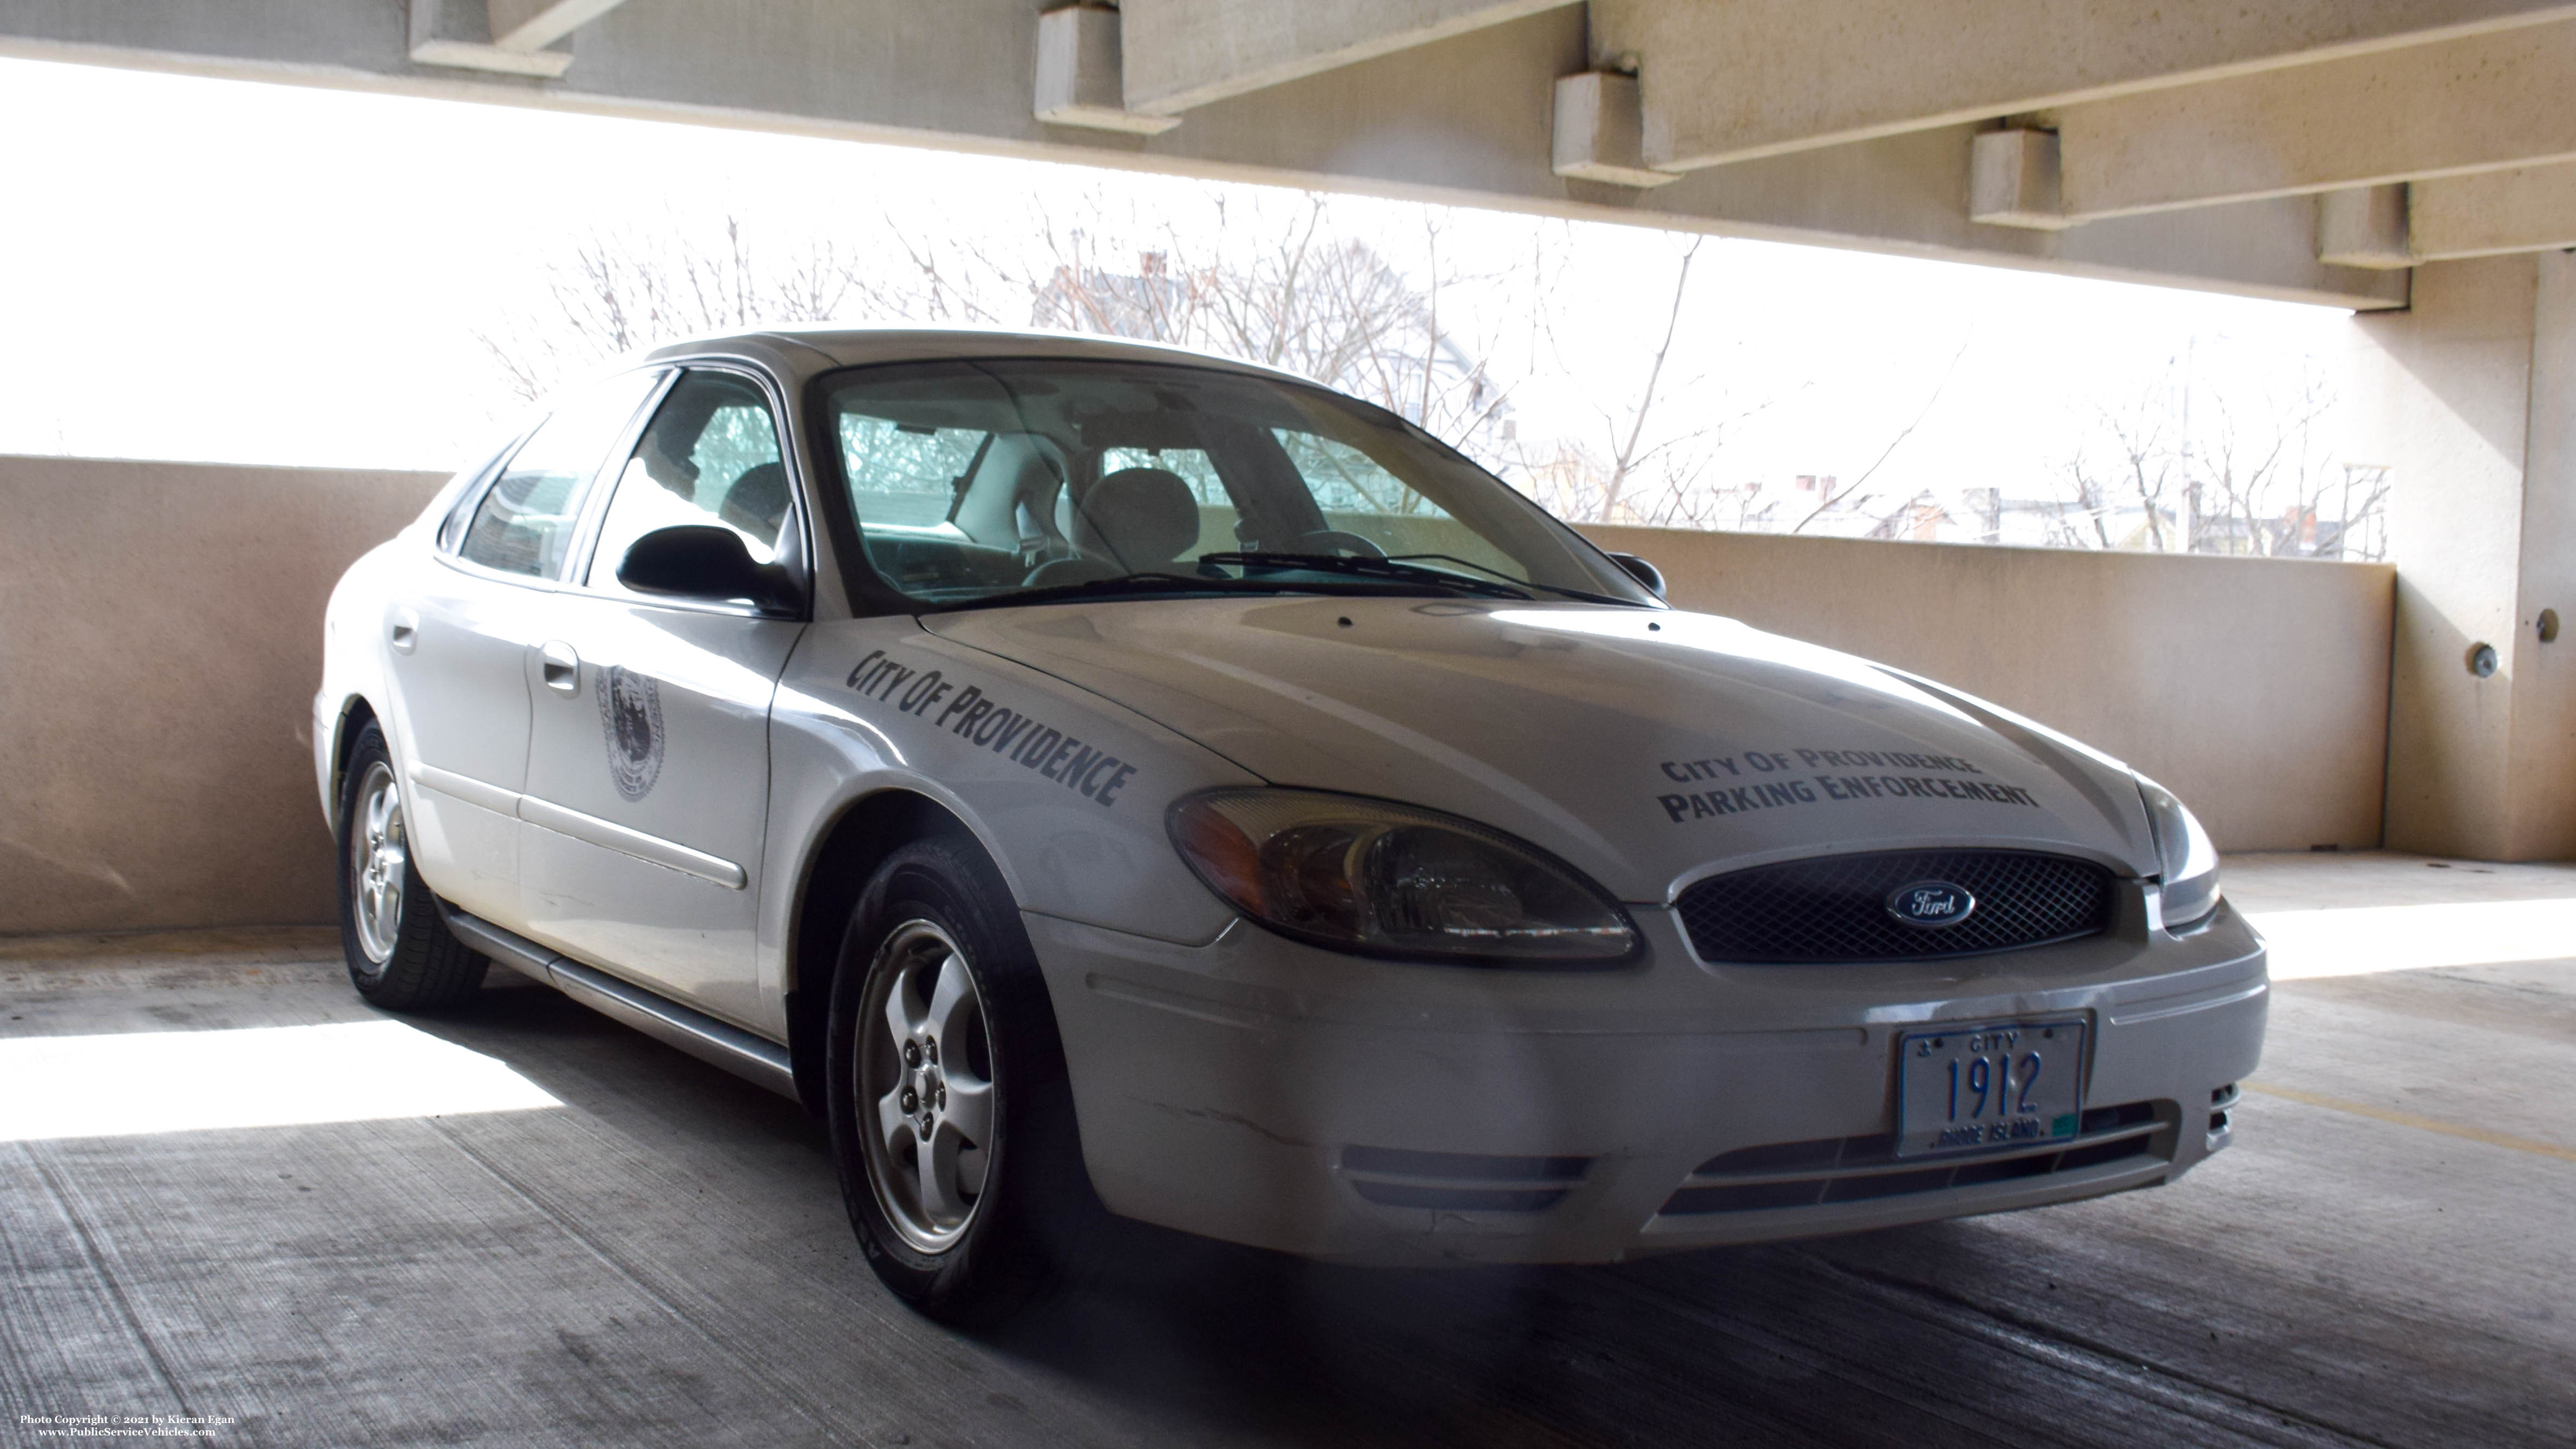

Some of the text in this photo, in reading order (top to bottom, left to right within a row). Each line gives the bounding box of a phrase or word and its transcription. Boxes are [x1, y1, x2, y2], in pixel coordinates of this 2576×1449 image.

[846, 650, 1137, 807] CITY OF PROVIDENCE
[1660, 748, 1983, 782] CITY OF PROVIDENCE
[1657, 775, 2041, 823] PARKING ENFORCEMENT
[1911, 890, 1956, 916] Ford
[1970, 1032, 2019, 1053] CITY
[1948, 1050, 2042, 1121] 1912
[1989, 1117, 2040, 1141] ISLAND
